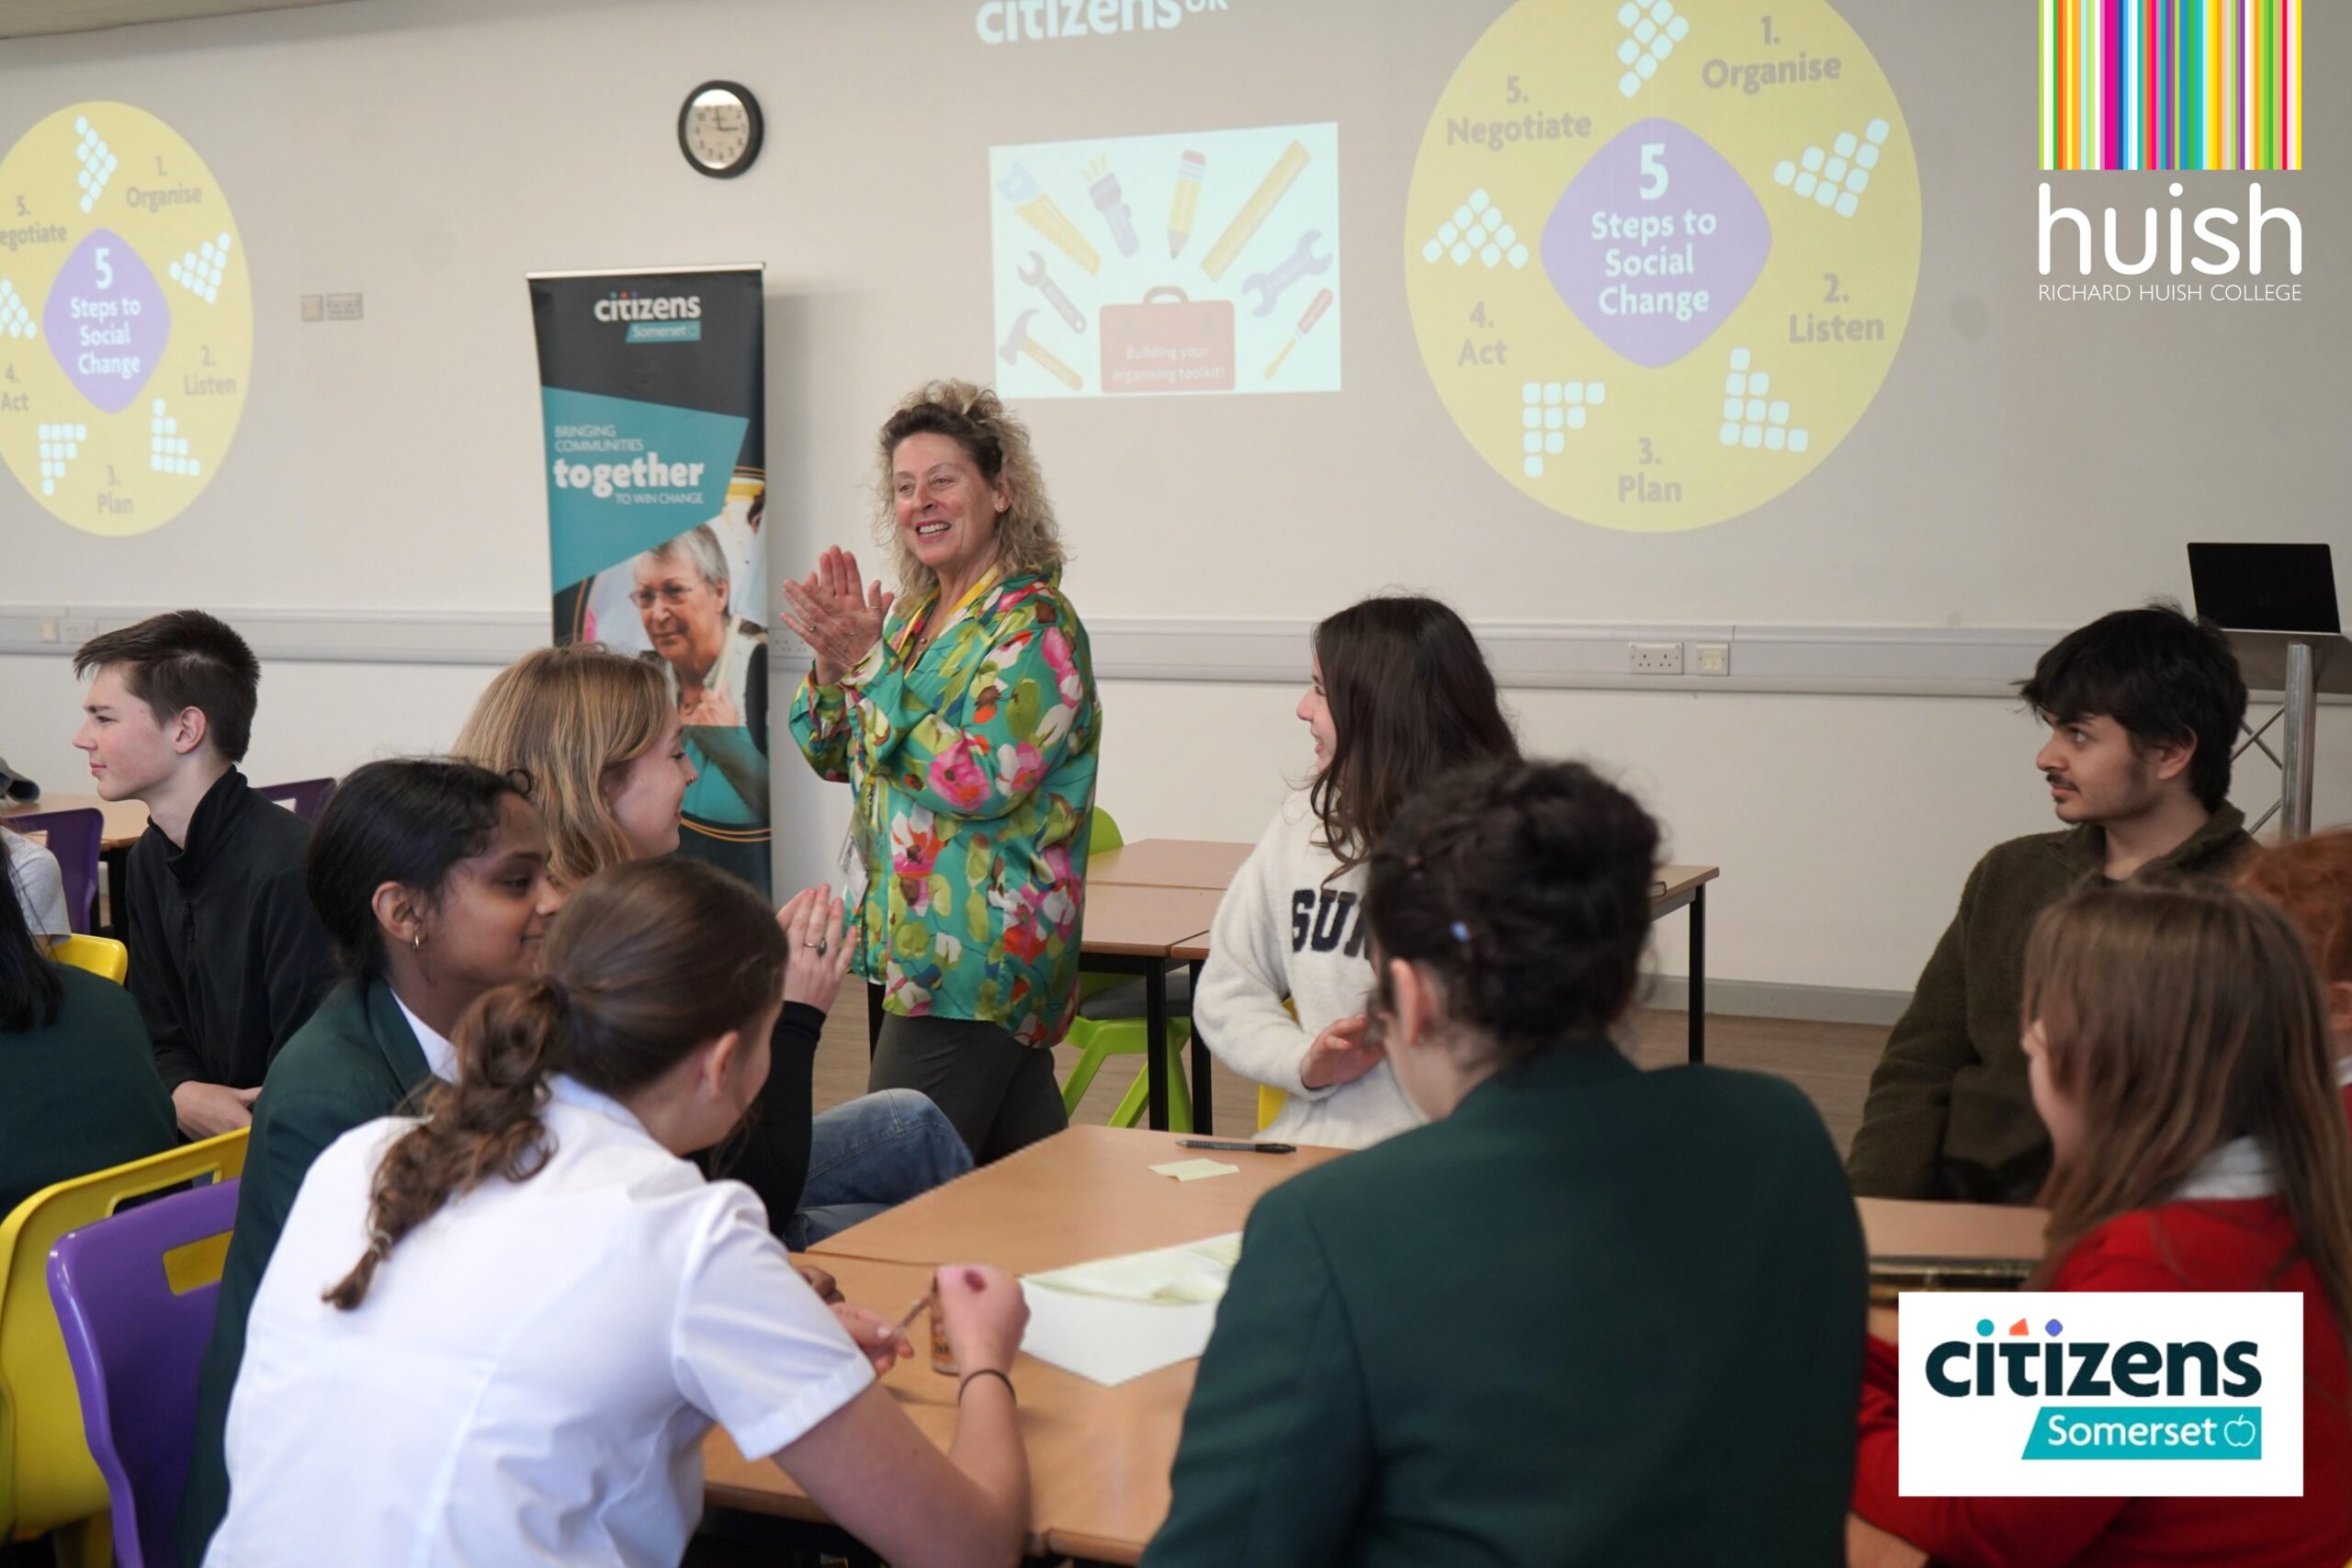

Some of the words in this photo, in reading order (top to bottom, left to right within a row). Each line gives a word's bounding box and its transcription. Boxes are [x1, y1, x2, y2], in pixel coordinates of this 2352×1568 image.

[976, 0, 1182, 44] citizens
[1761, 16, 1781, 45] 1.
[1702, 51, 1842, 95] Organise
[1507, 75, 1530, 105] 5.
[1446, 111, 1591, 152] Negotiate
[1639, 143, 1669, 200] 5
[126, 182, 202, 212] Organise
[0, 222, 67, 252] egotiate
[1591, 211, 1675, 246] Steps
[1683, 209, 1716, 236] to
[96, 247, 113, 288] 5
[1606, 243, 1694, 276] Social
[1823, 273, 1849, 303] 2.
[71, 297, 117, 322] Steps
[122, 299, 141, 316] to
[594, 291, 701, 321] citizens
[1470, 302, 1494, 329] 4.
[1599, 286, 1710, 322] Change
[80, 324, 130, 345] Social
[633, 324, 687, 339] Somerset
[1789, 314, 1884, 344] Listen
[78, 352, 141, 378] Change
[1126, 347, 1177, 361] Building
[1180, 346, 1209, 360] your
[1458, 340, 1508, 367] Act
[185, 374, 237, 396] Listen
[1112, 367, 1176, 384] organising
[1, 391, 28, 412] Act
[555, 425, 616, 438] BRINGING
[555, 438, 643, 452] COMMUNITIES
[1639, 437, 1661, 466] 3.
[553, 452, 705, 498] together
[1619, 474, 1682, 504] Plan
[97, 493, 133, 513] Plan
[616, 493, 632, 504] TO
[634, 493, 657, 504] WIN
[660, 492, 704, 504] CHANGE
